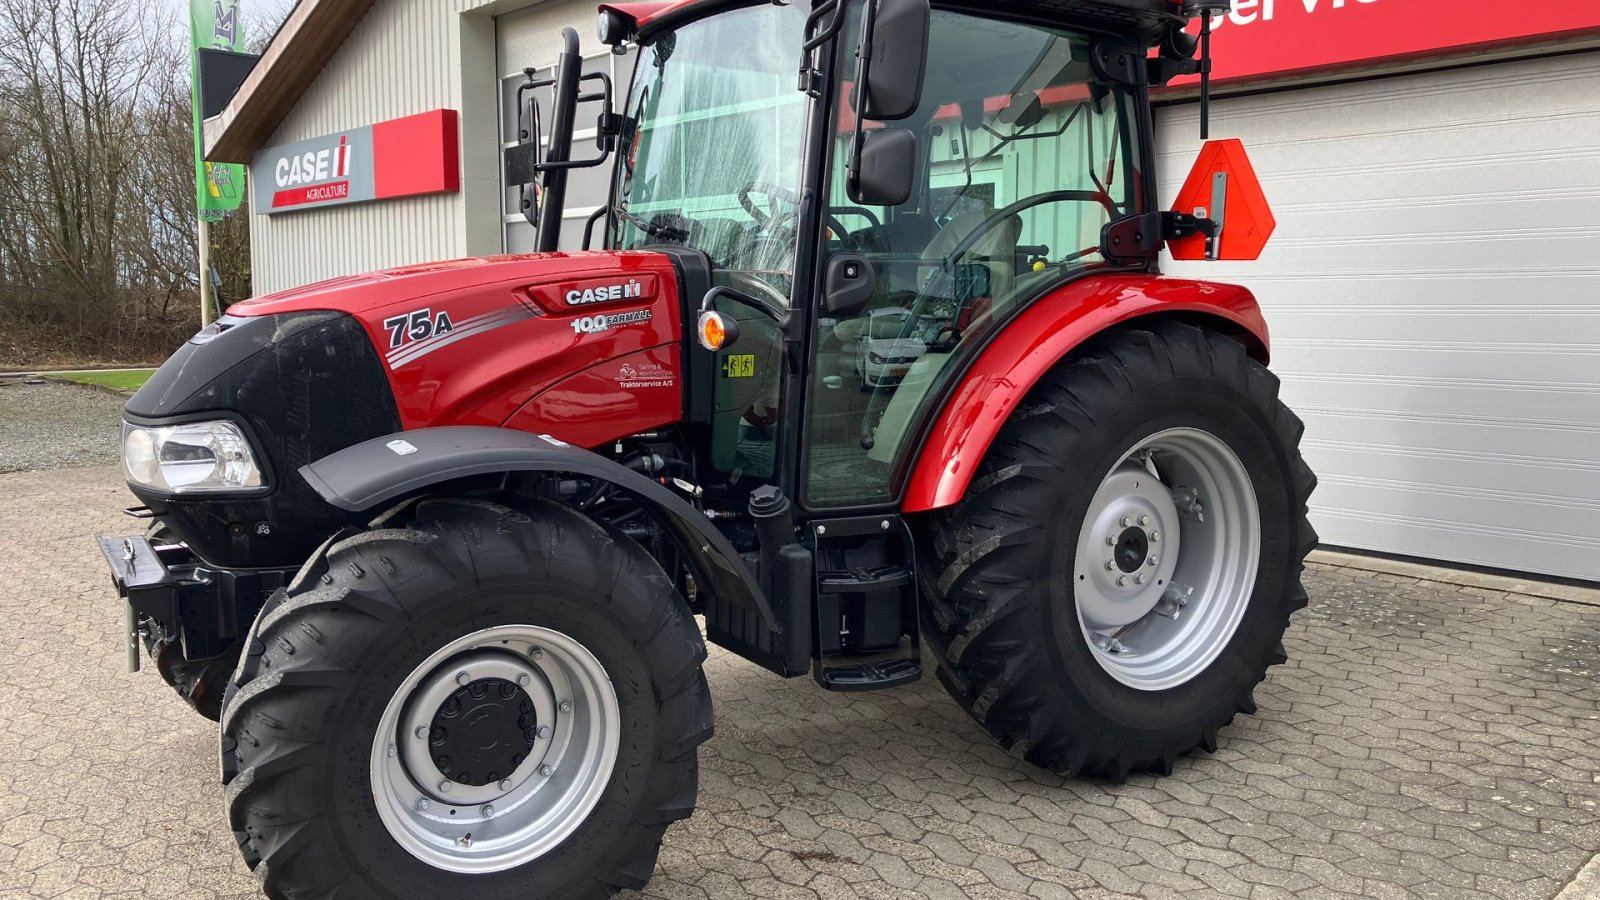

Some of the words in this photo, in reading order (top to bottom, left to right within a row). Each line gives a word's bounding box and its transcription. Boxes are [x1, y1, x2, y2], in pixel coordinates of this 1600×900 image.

[275, 149, 329, 187] CASE
[306, 184, 347, 200] AGRICULTURE
[565, 285, 621, 306] CASE
[570, 315, 607, 334] 100
[606, 310, 652, 326] FARMALL
